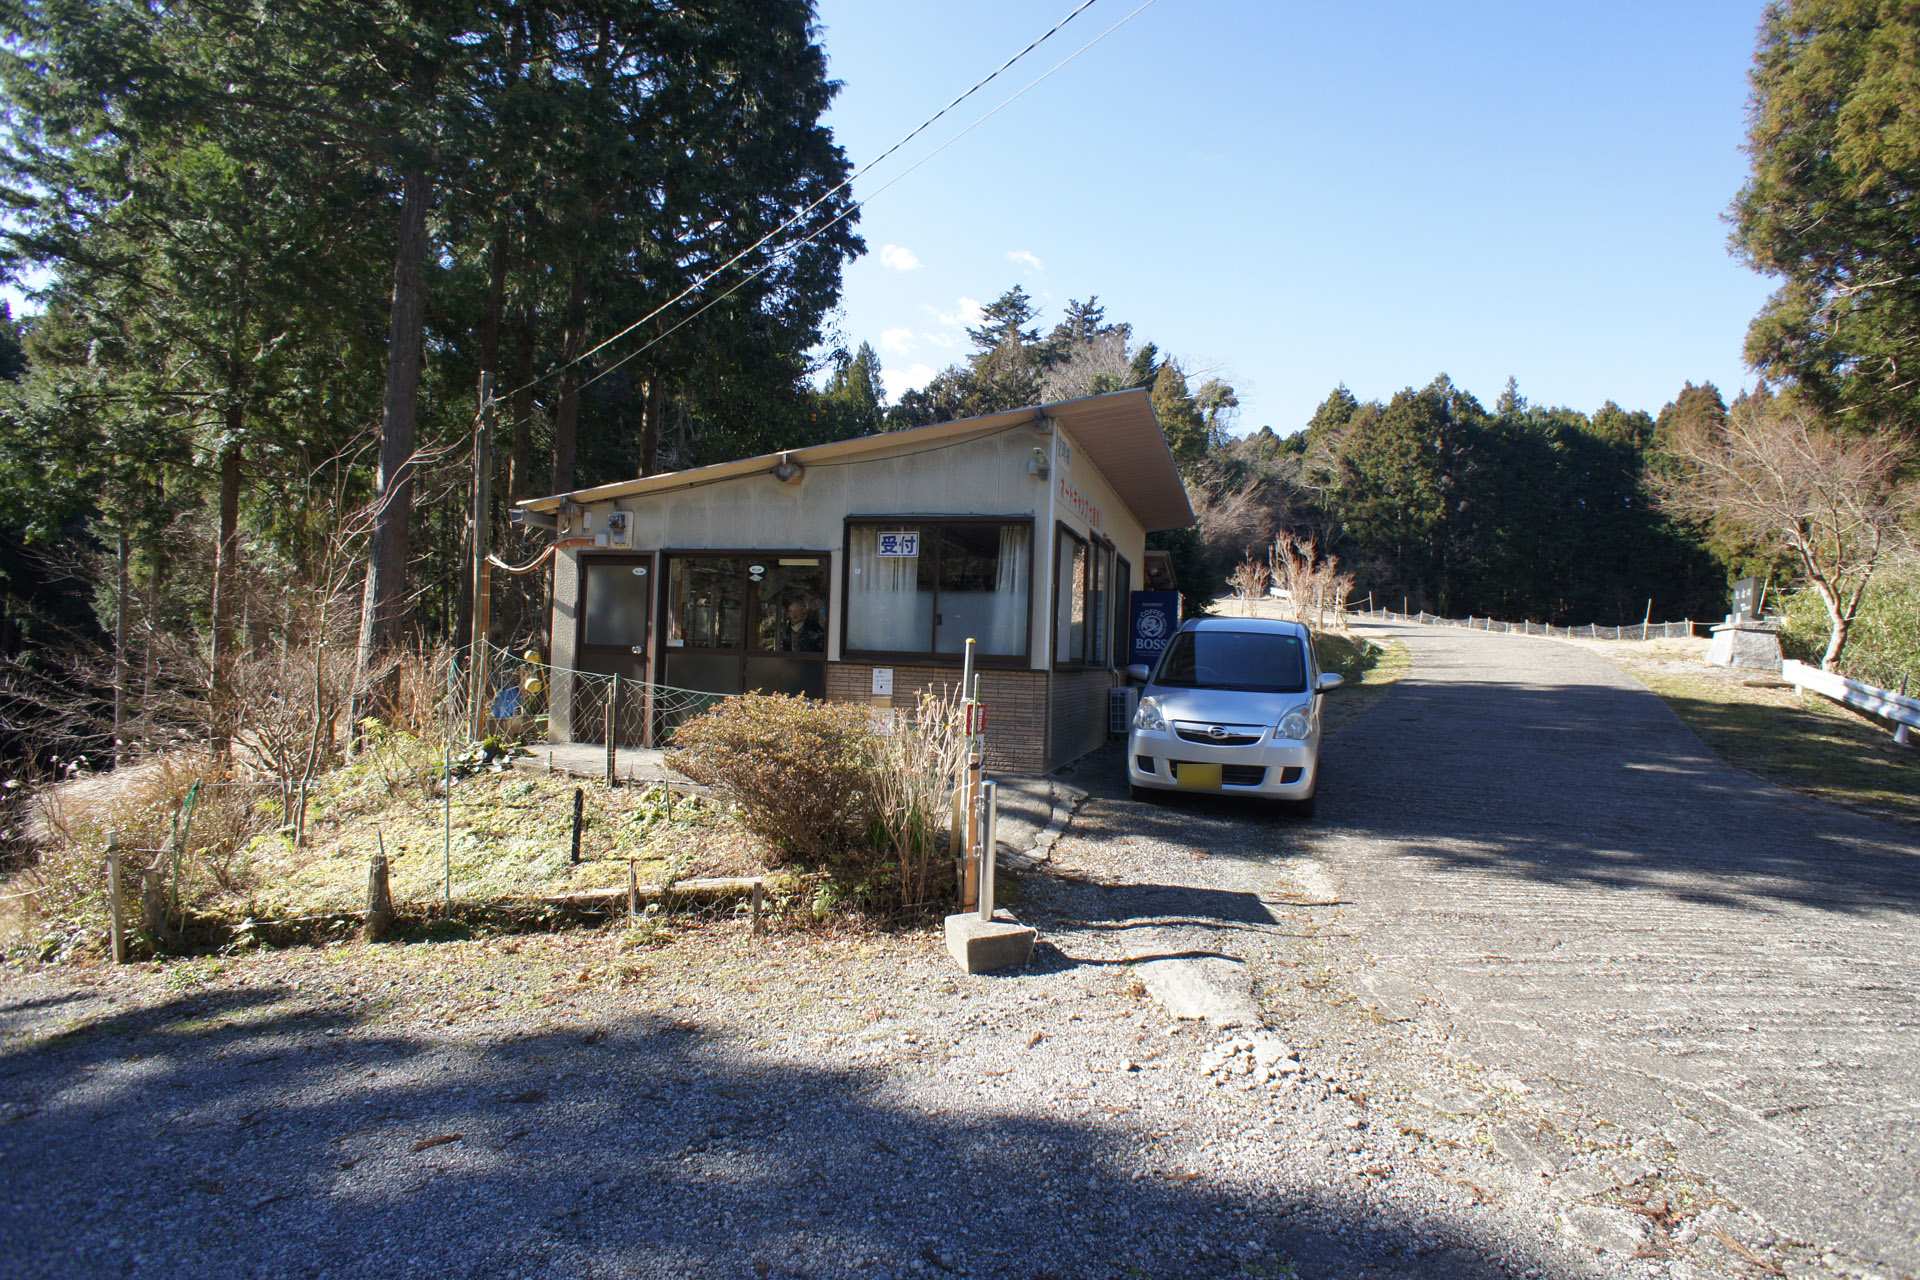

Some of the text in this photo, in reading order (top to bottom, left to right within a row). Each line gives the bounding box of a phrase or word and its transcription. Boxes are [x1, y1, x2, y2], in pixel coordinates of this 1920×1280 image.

[881, 535, 916, 554] 受付
[1140, 608, 1165, 618] COFFEE
[1135, 638, 1168, 650] BOSS
